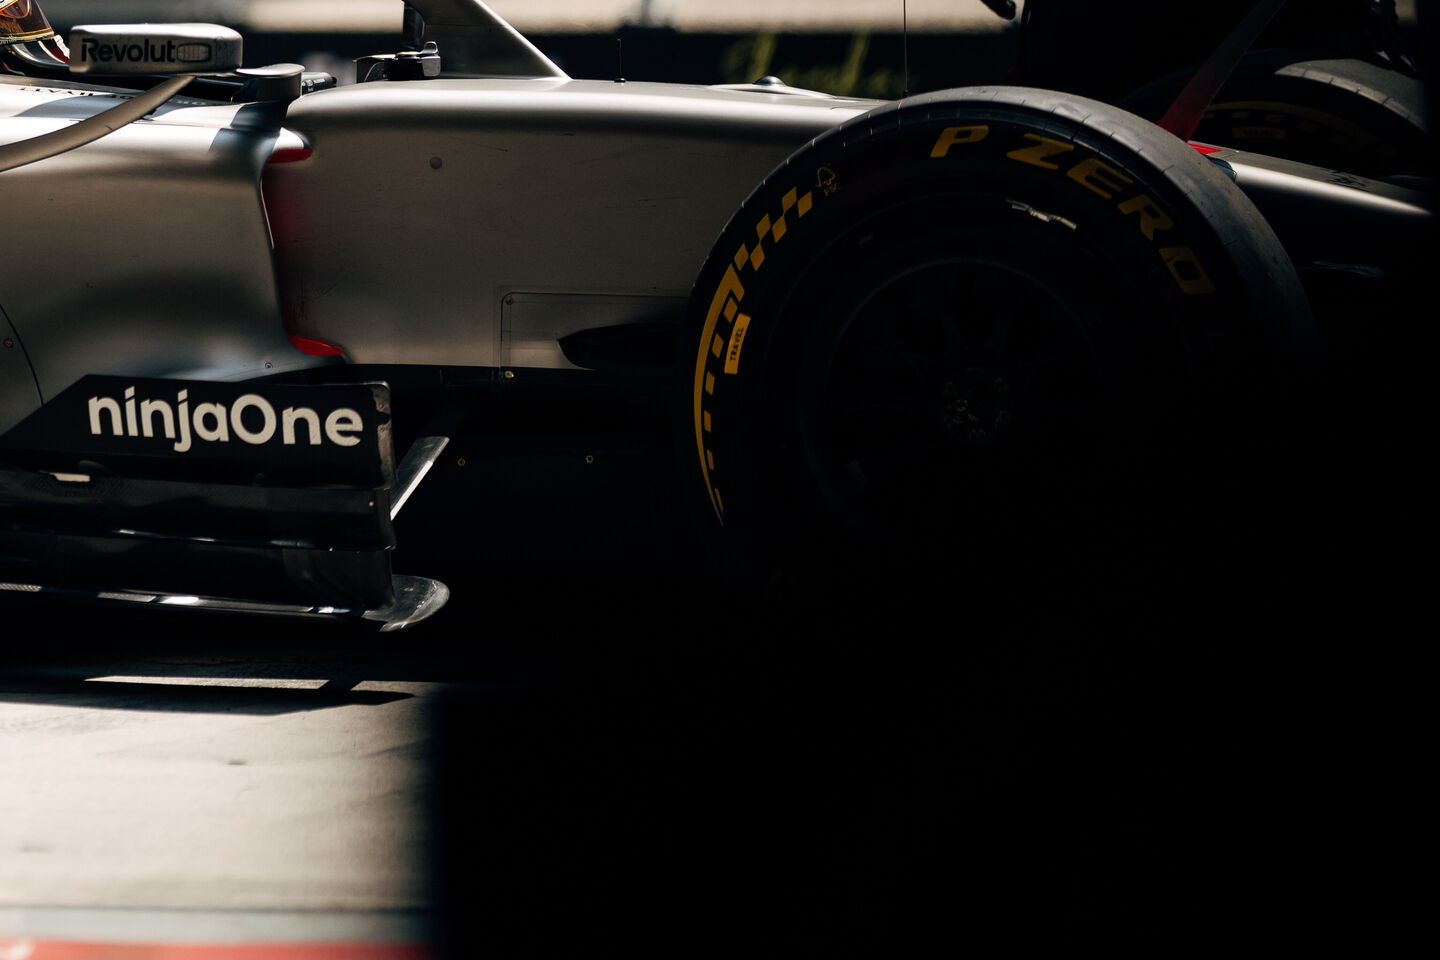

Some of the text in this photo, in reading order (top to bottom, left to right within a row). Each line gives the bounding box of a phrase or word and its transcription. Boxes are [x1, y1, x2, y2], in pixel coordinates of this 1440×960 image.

[80, 38, 176, 63] Revolut
[929, 124, 1216, 297] P ZERO
[88, 385, 365, 453] ninjaOne
